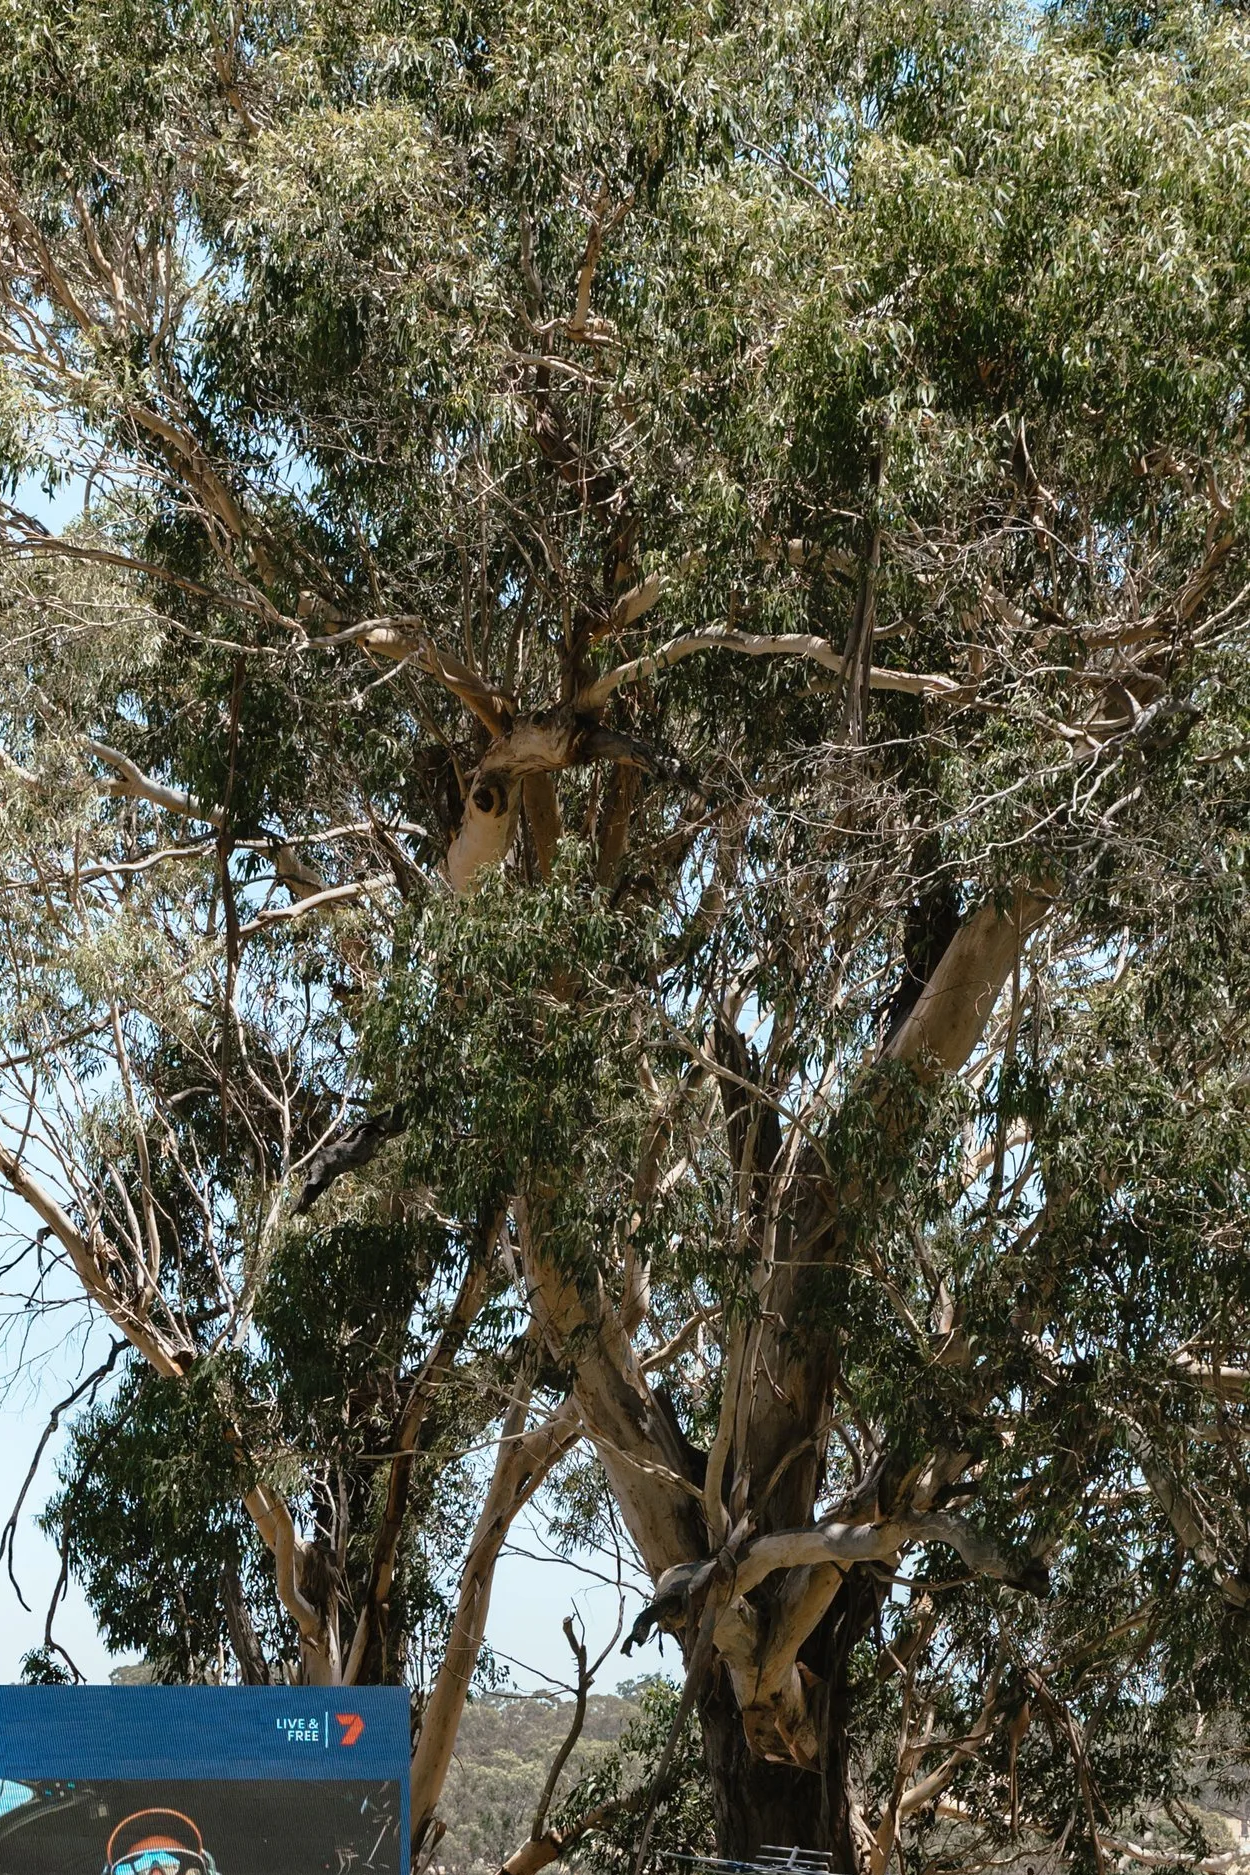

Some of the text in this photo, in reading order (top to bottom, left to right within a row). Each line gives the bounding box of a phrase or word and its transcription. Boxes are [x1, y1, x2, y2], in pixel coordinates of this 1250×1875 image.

[276, 1718, 319, 1729] LIVE &
[288, 1730, 319, 1741] FREE
